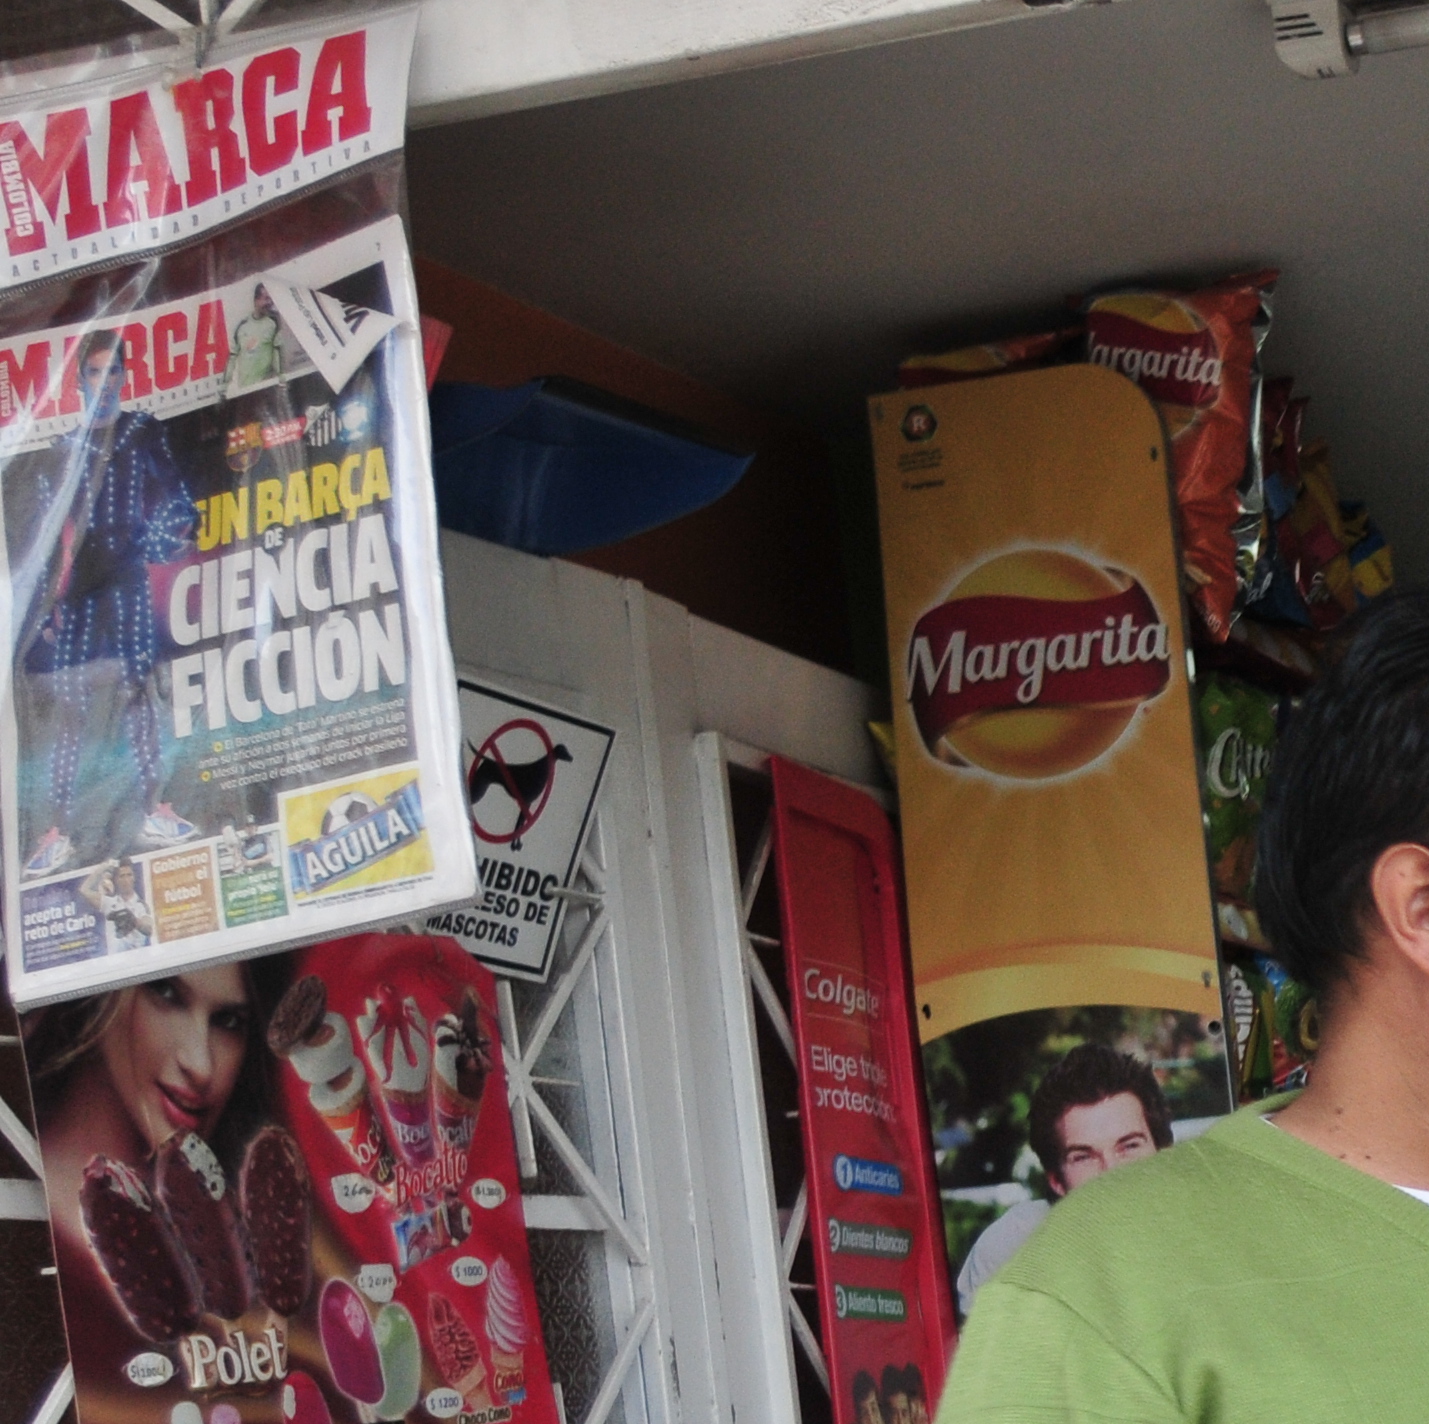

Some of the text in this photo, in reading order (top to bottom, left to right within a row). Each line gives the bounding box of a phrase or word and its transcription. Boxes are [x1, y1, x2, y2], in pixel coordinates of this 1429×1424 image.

[0, 30, 372, 256] MARCA
[11, 140, 371, 278] ACTUALIDAD DEPORTIVA
[1088, 331, 1223, 387] argarita
[256, 447, 392, 534] BARÇA
[264, 527, 283, 549] DE
[169, 514, 399, 646] CIENCIA
[171, 603, 405, 739] FICCIÓN
[907, 612, 1170, 704] Margarita
[24, 902, 76, 927] acepta el
[24, 924, 49, 941] reto
[50, 921, 65, 936] de
[426, 912, 520, 948] MASCOTAS
[523, 902, 550, 926] DE
[803, 967, 880, 1017] Colgate
[810, 1045, 858, 1082] Elige
[842, 1224, 875, 1249] Dientes
[187, 1327, 289, 1389] Polet
